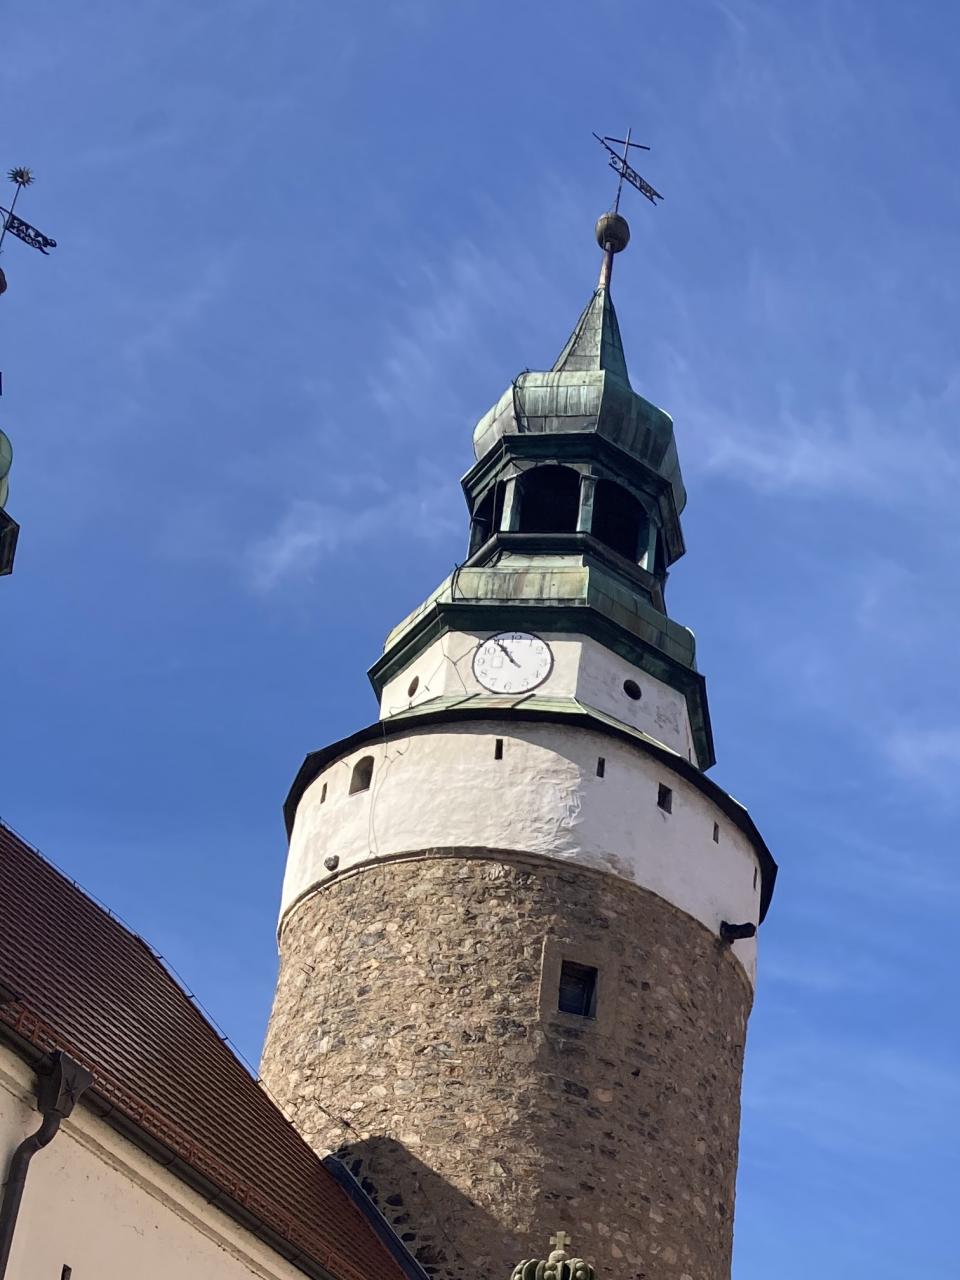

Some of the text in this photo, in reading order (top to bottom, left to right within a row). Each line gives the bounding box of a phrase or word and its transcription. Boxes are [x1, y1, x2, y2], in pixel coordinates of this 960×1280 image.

[511, 634, 523, 643] 12
[484, 647, 496, 655] 10
[536, 645, 544, 654] 2
[477, 658, 485, 666] 9
[490, 677, 498, 686] 7
[503, 681, 512, 690] 6
